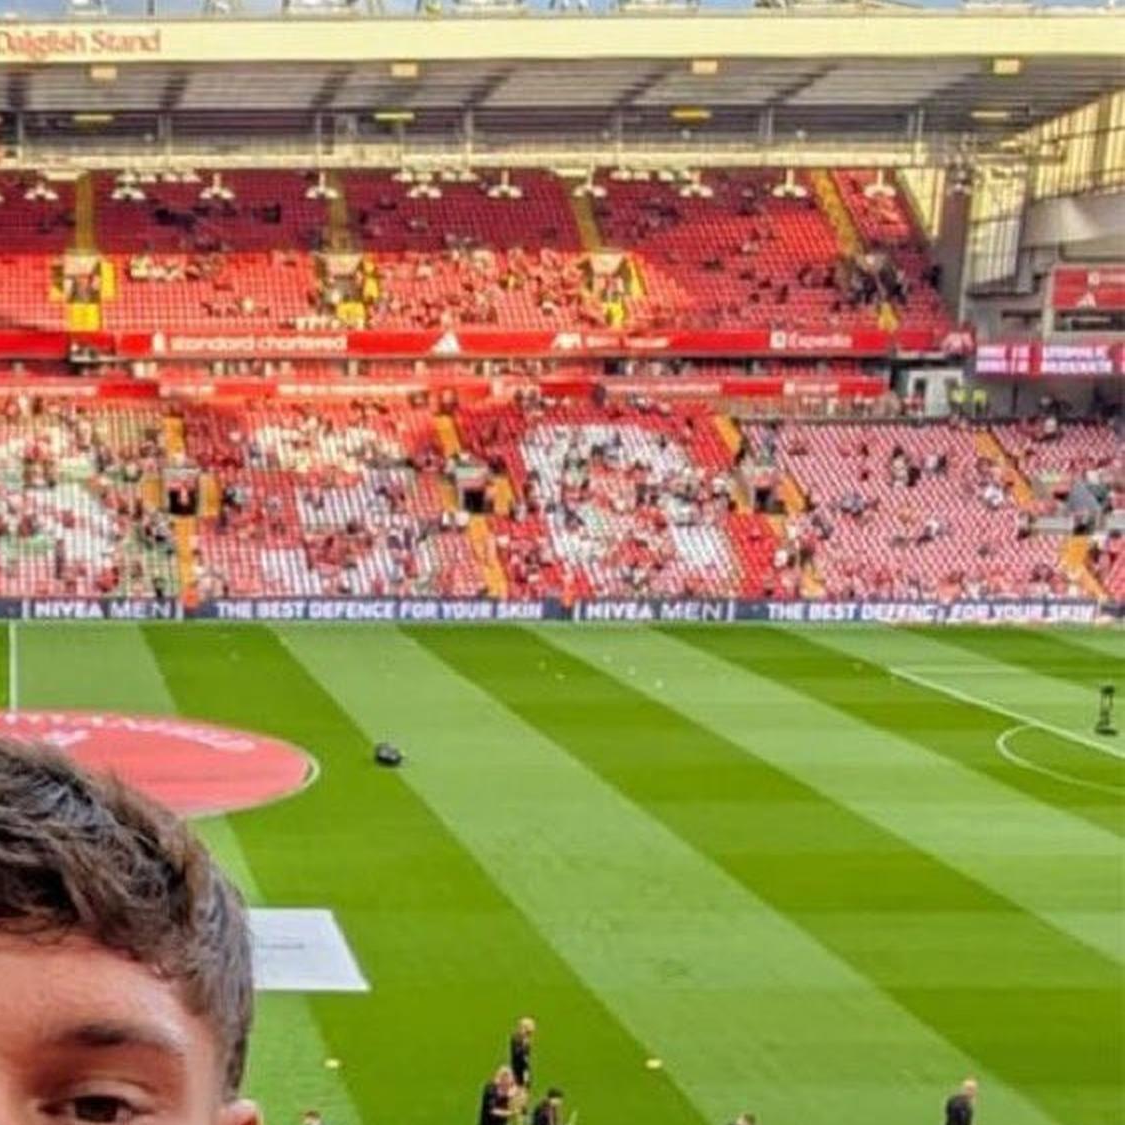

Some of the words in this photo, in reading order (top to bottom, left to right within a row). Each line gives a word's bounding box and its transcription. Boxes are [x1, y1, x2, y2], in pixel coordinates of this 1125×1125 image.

[90, 30, 161, 53] Stand
[34, 601, 103, 618] NIVEA
[109, 601, 172, 618] MEN
[216, 601, 253, 618] THE
[255, 601, 304, 618] BEST
[307, 601, 395, 618] DEFENCE
[399, 601, 438, 618] FOR
[441, 601, 492, 618] YOUR
[496, 601, 543, 618] SKIN
[585, 602, 653, 619] NIVEA
[659, 602, 723, 620] MEN
[767, 602, 804, 619] THE
[808, 602, 856, 619] BEST
